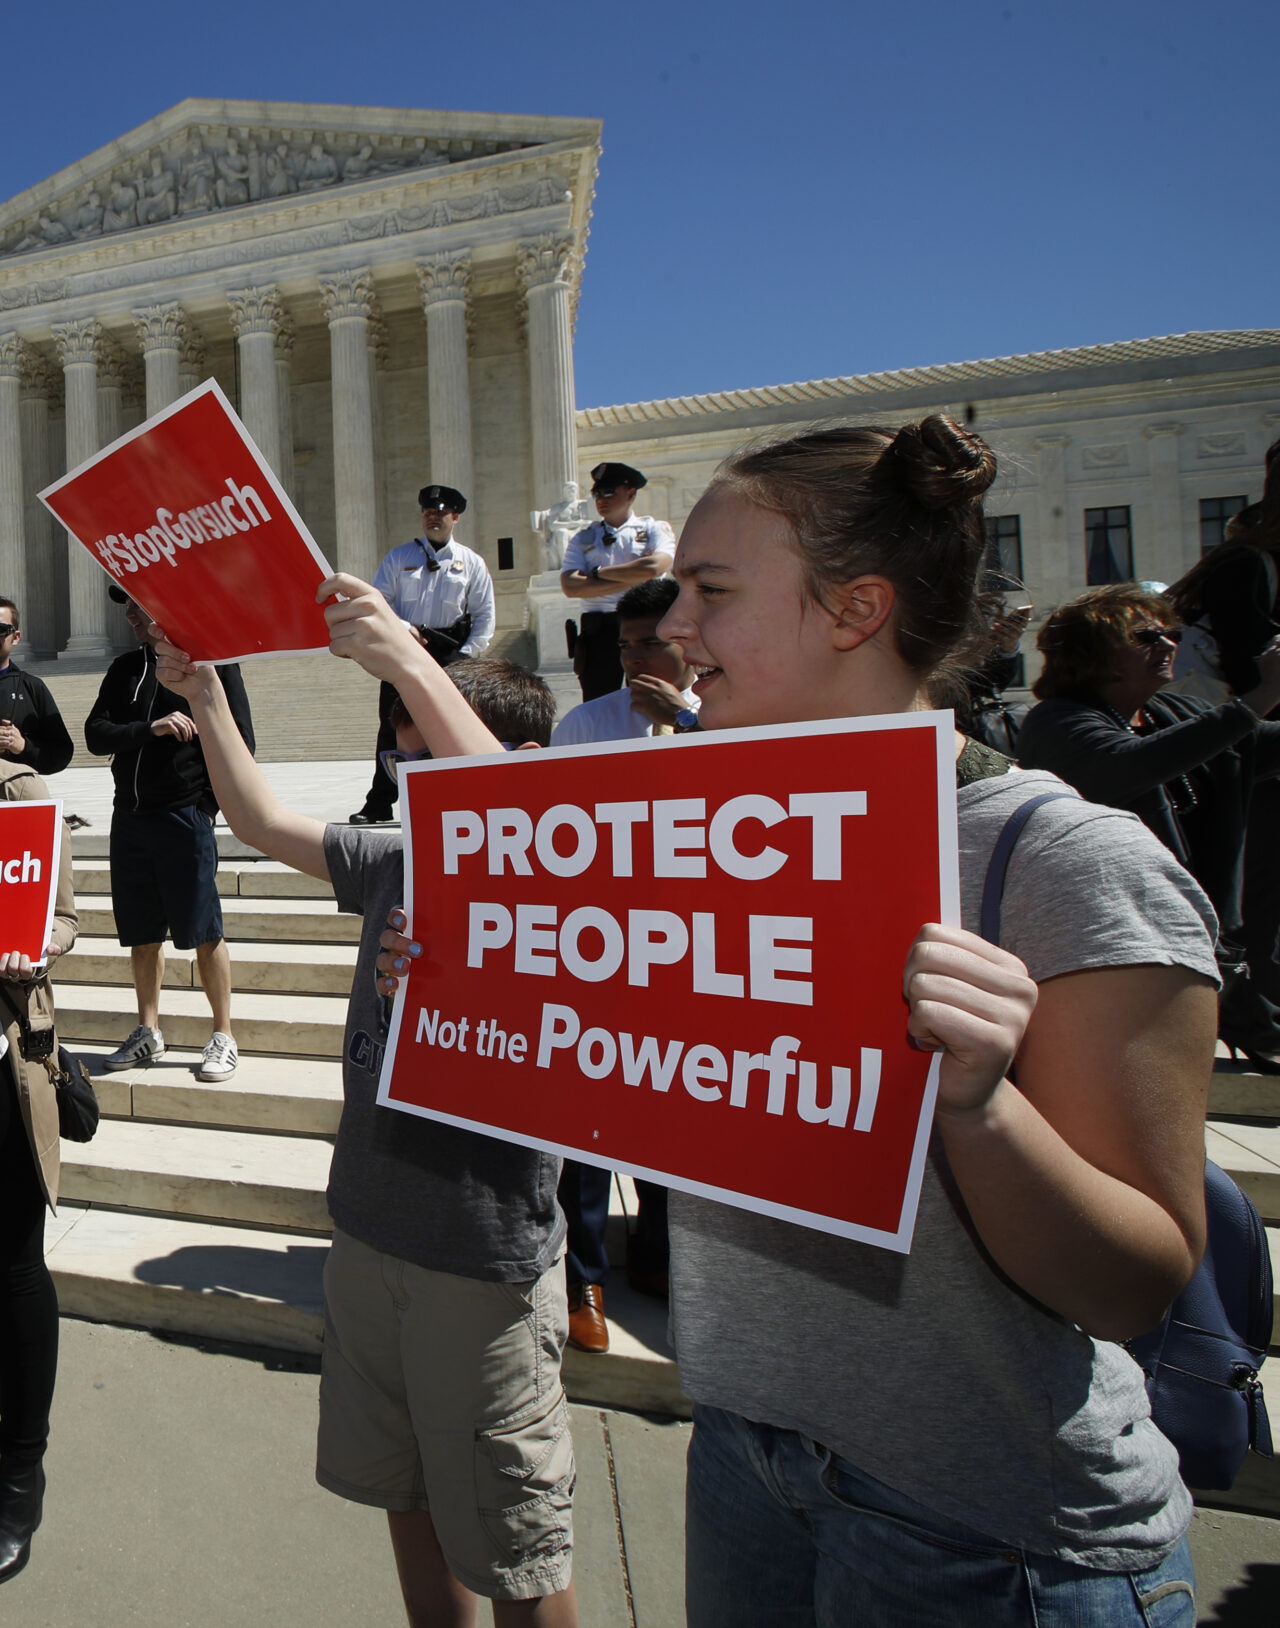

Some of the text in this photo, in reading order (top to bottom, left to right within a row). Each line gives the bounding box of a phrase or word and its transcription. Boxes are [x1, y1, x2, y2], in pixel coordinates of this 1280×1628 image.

[146, 254, 214, 279] JUSTICE
[223, 241, 283, 263] UNDER
[292, 231, 329, 250] LAW
[95, 477, 272, 578] #StopGorsuch
[441, 790, 868, 881] PROTECT
[467, 902, 814, 1006] PEOPLE
[415, 1002, 883, 1133] Not the Powerful
